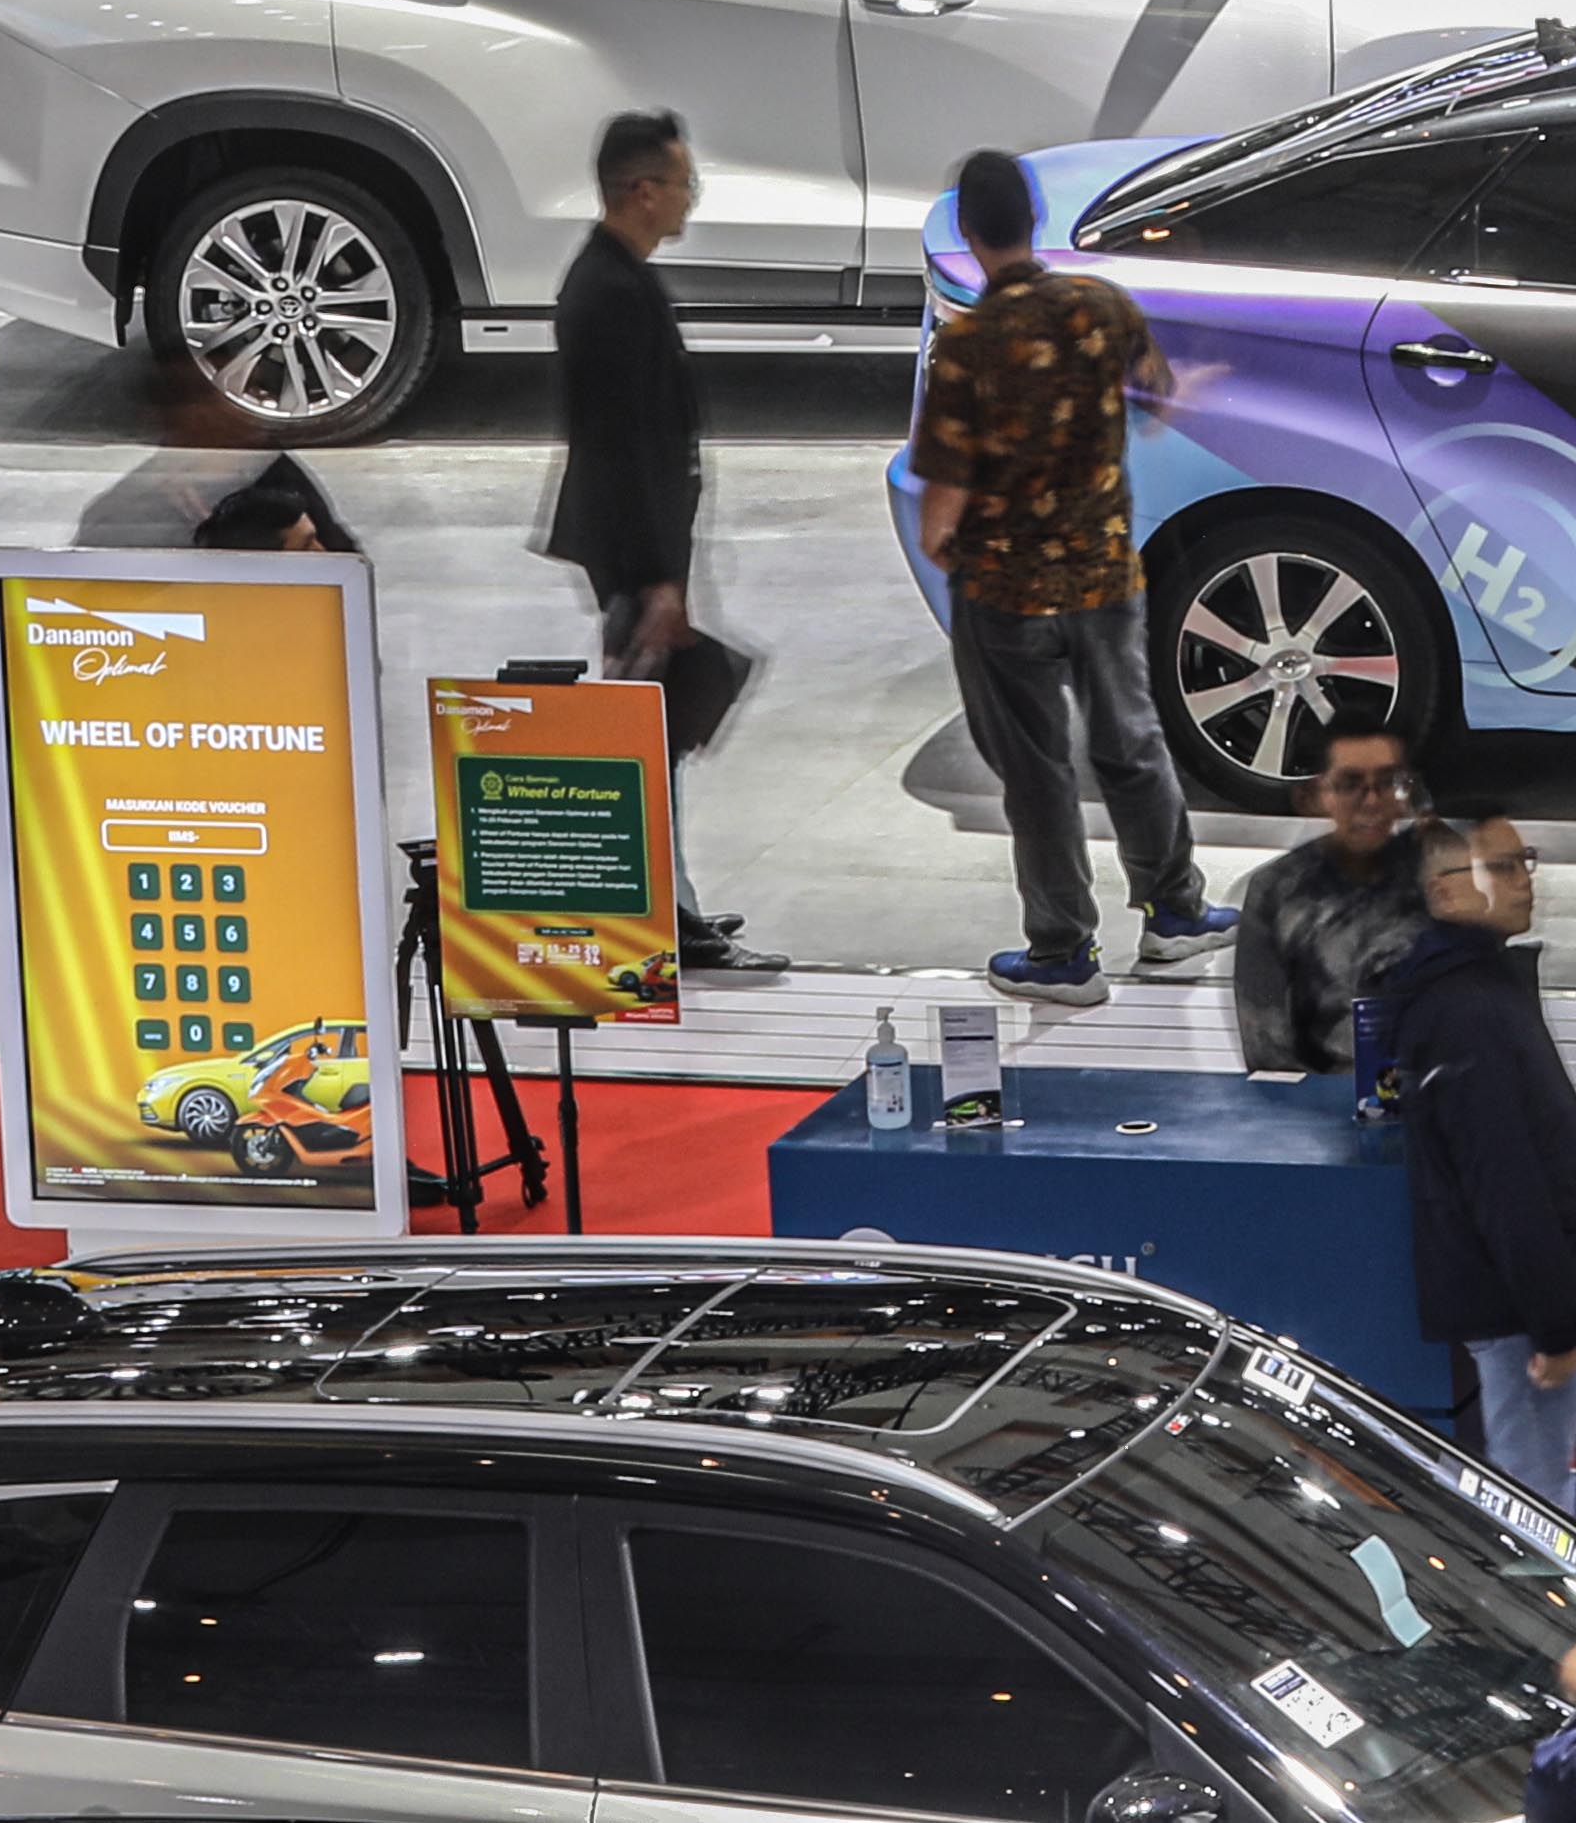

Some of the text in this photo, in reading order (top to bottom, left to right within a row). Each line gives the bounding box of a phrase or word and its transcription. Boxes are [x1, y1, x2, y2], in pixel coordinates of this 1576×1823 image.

[28, 623, 134, 646] Danamon
[73, 648, 167, 685] Optimal
[436, 703, 494, 716] Danamon
[41, 721, 325, 752] WHEEL OF FORTUNE
[507, 786, 620, 800] Wheel of Fortune
[105, 799, 266, 814] MASUKKAN KODE VOUCHER
[139, 874, 235, 891] 1 2 3
[140, 924, 238, 942] 4 5 6
[143, 974, 240, 992] 7 8 9
[190, 1026, 202, 1041] 0
